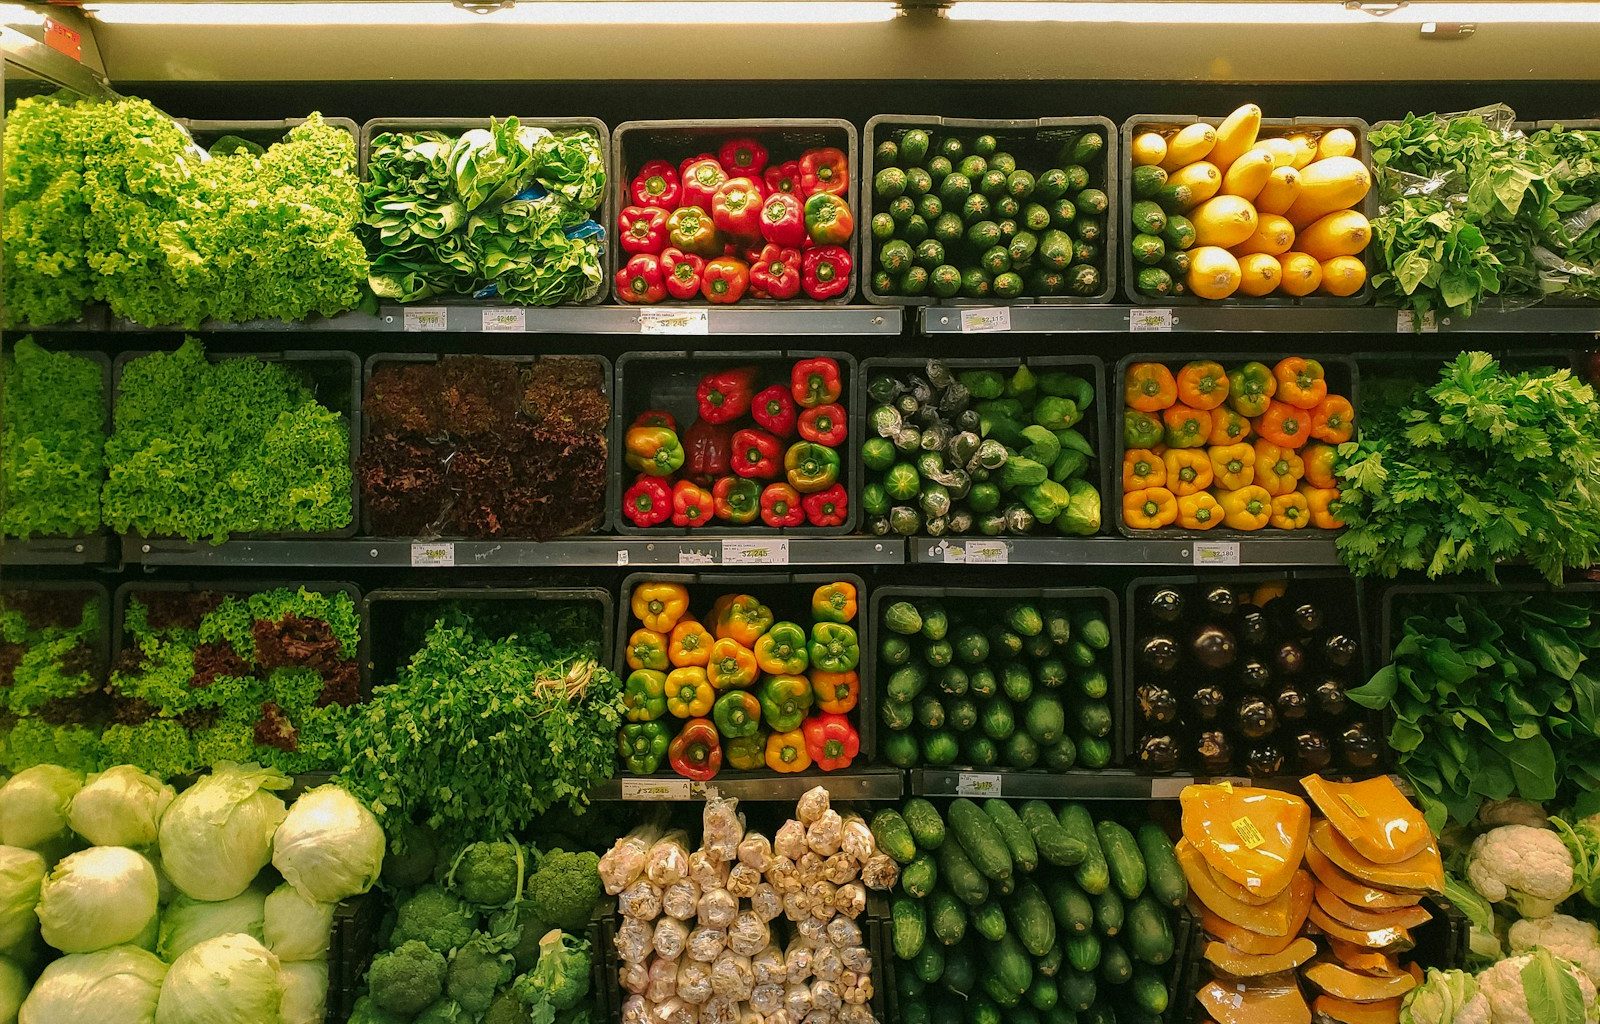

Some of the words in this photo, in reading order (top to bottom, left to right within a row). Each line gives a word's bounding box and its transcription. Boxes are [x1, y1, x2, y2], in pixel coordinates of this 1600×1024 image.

[700, 313, 707, 321] A
[780, 543, 786, 551] A
[741, 550, 768, 558] $2,245
